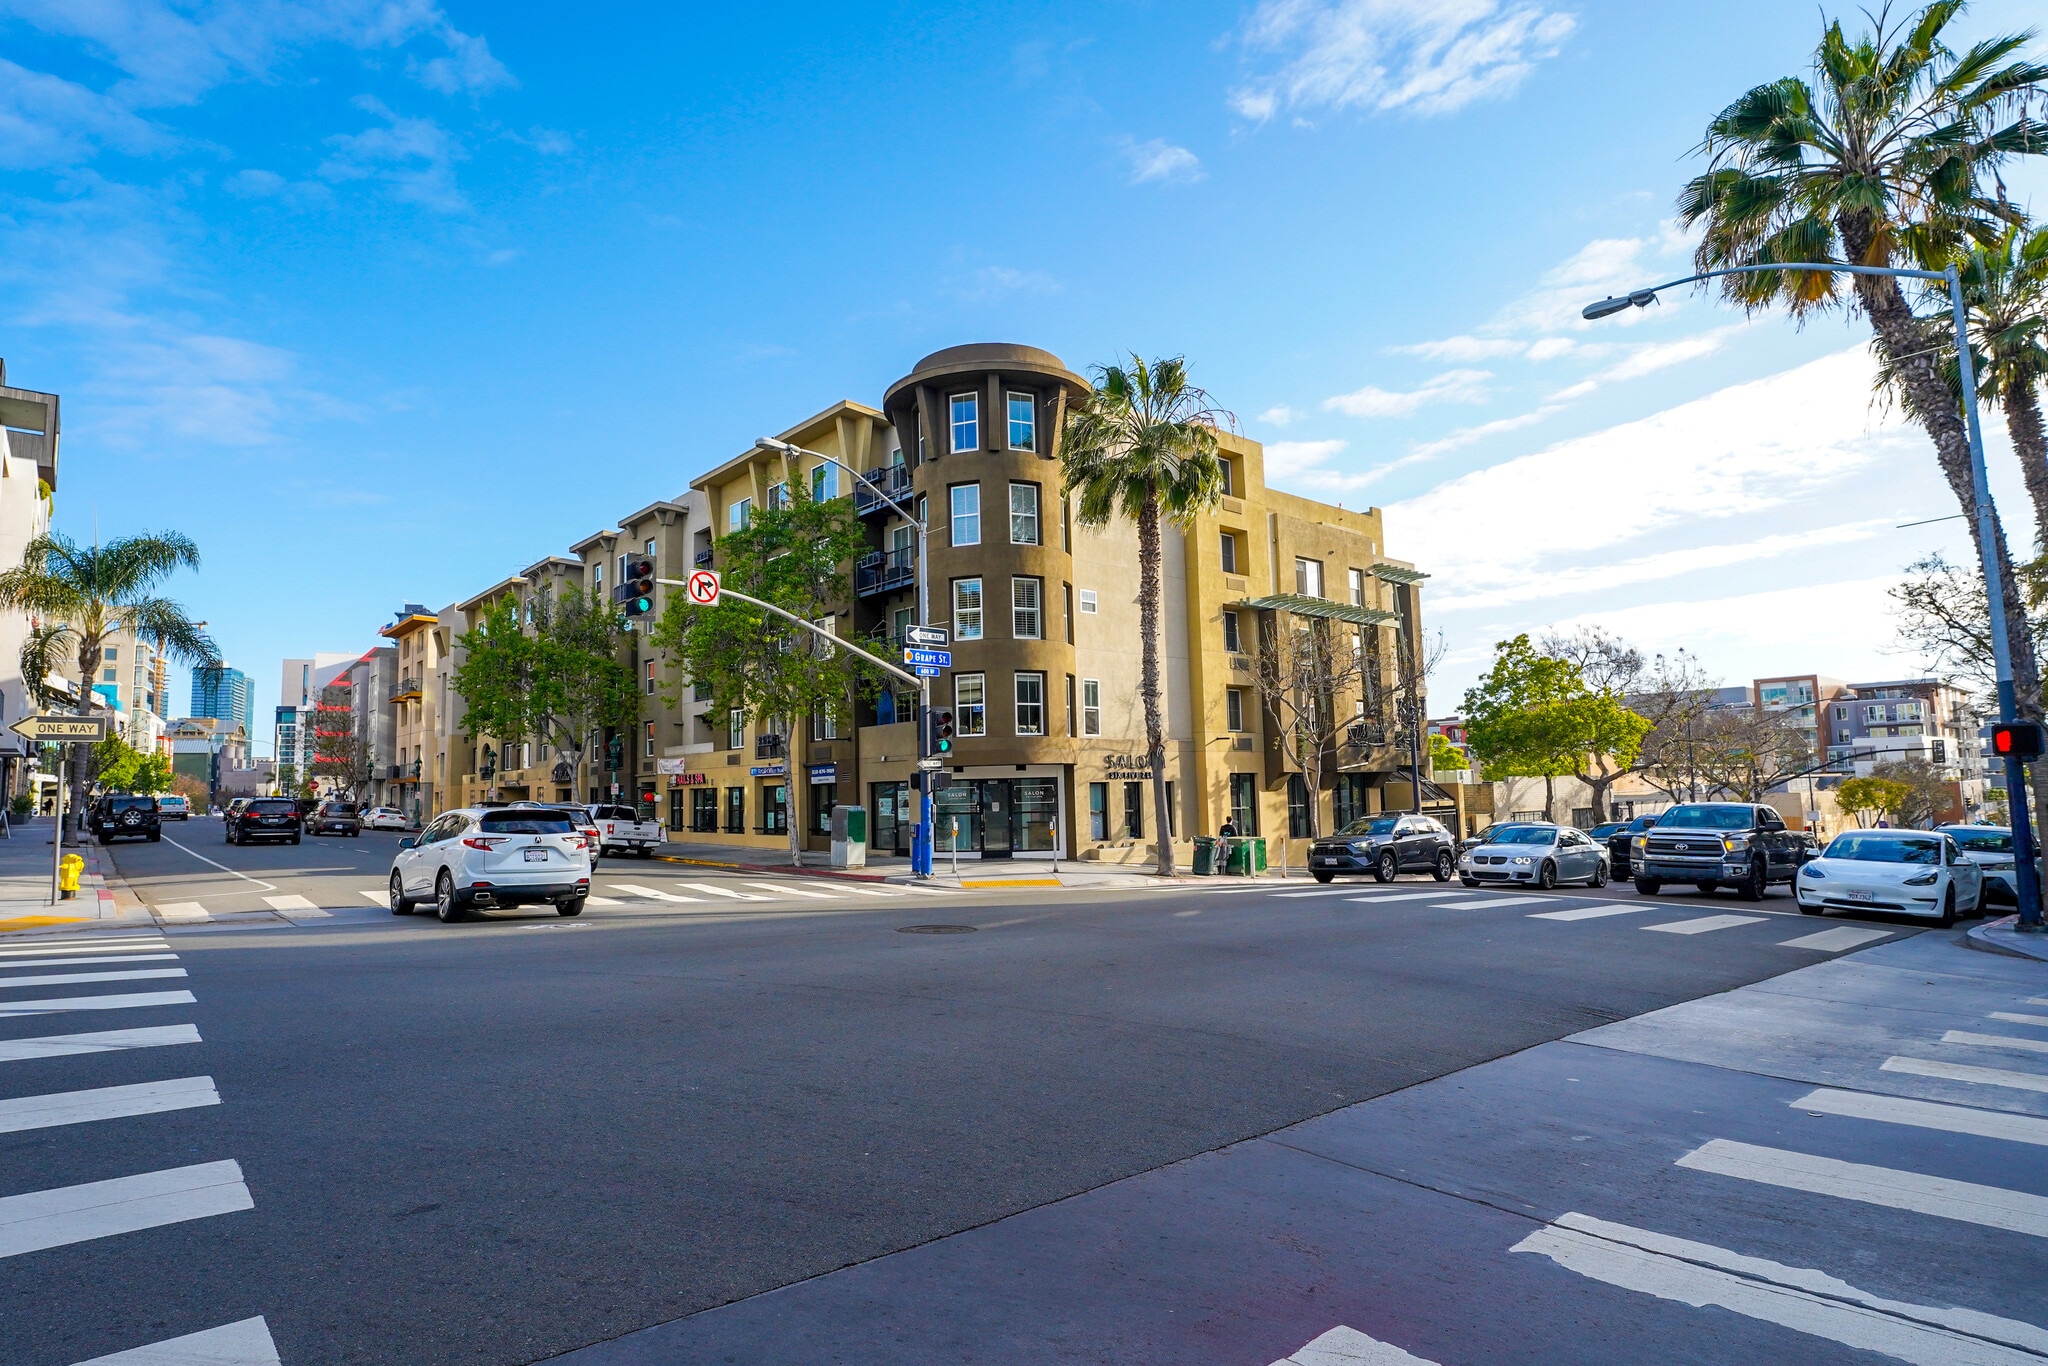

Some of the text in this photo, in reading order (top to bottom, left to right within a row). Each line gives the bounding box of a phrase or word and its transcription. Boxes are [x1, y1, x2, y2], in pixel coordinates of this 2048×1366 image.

[919, 632, 929, 640] ONE
[38, 723, 95, 734] ONE WAY
[1103, 754, 1150, 770] SALO
[676, 774, 690, 785] NAILS
[695, 773, 704, 784] SPA
